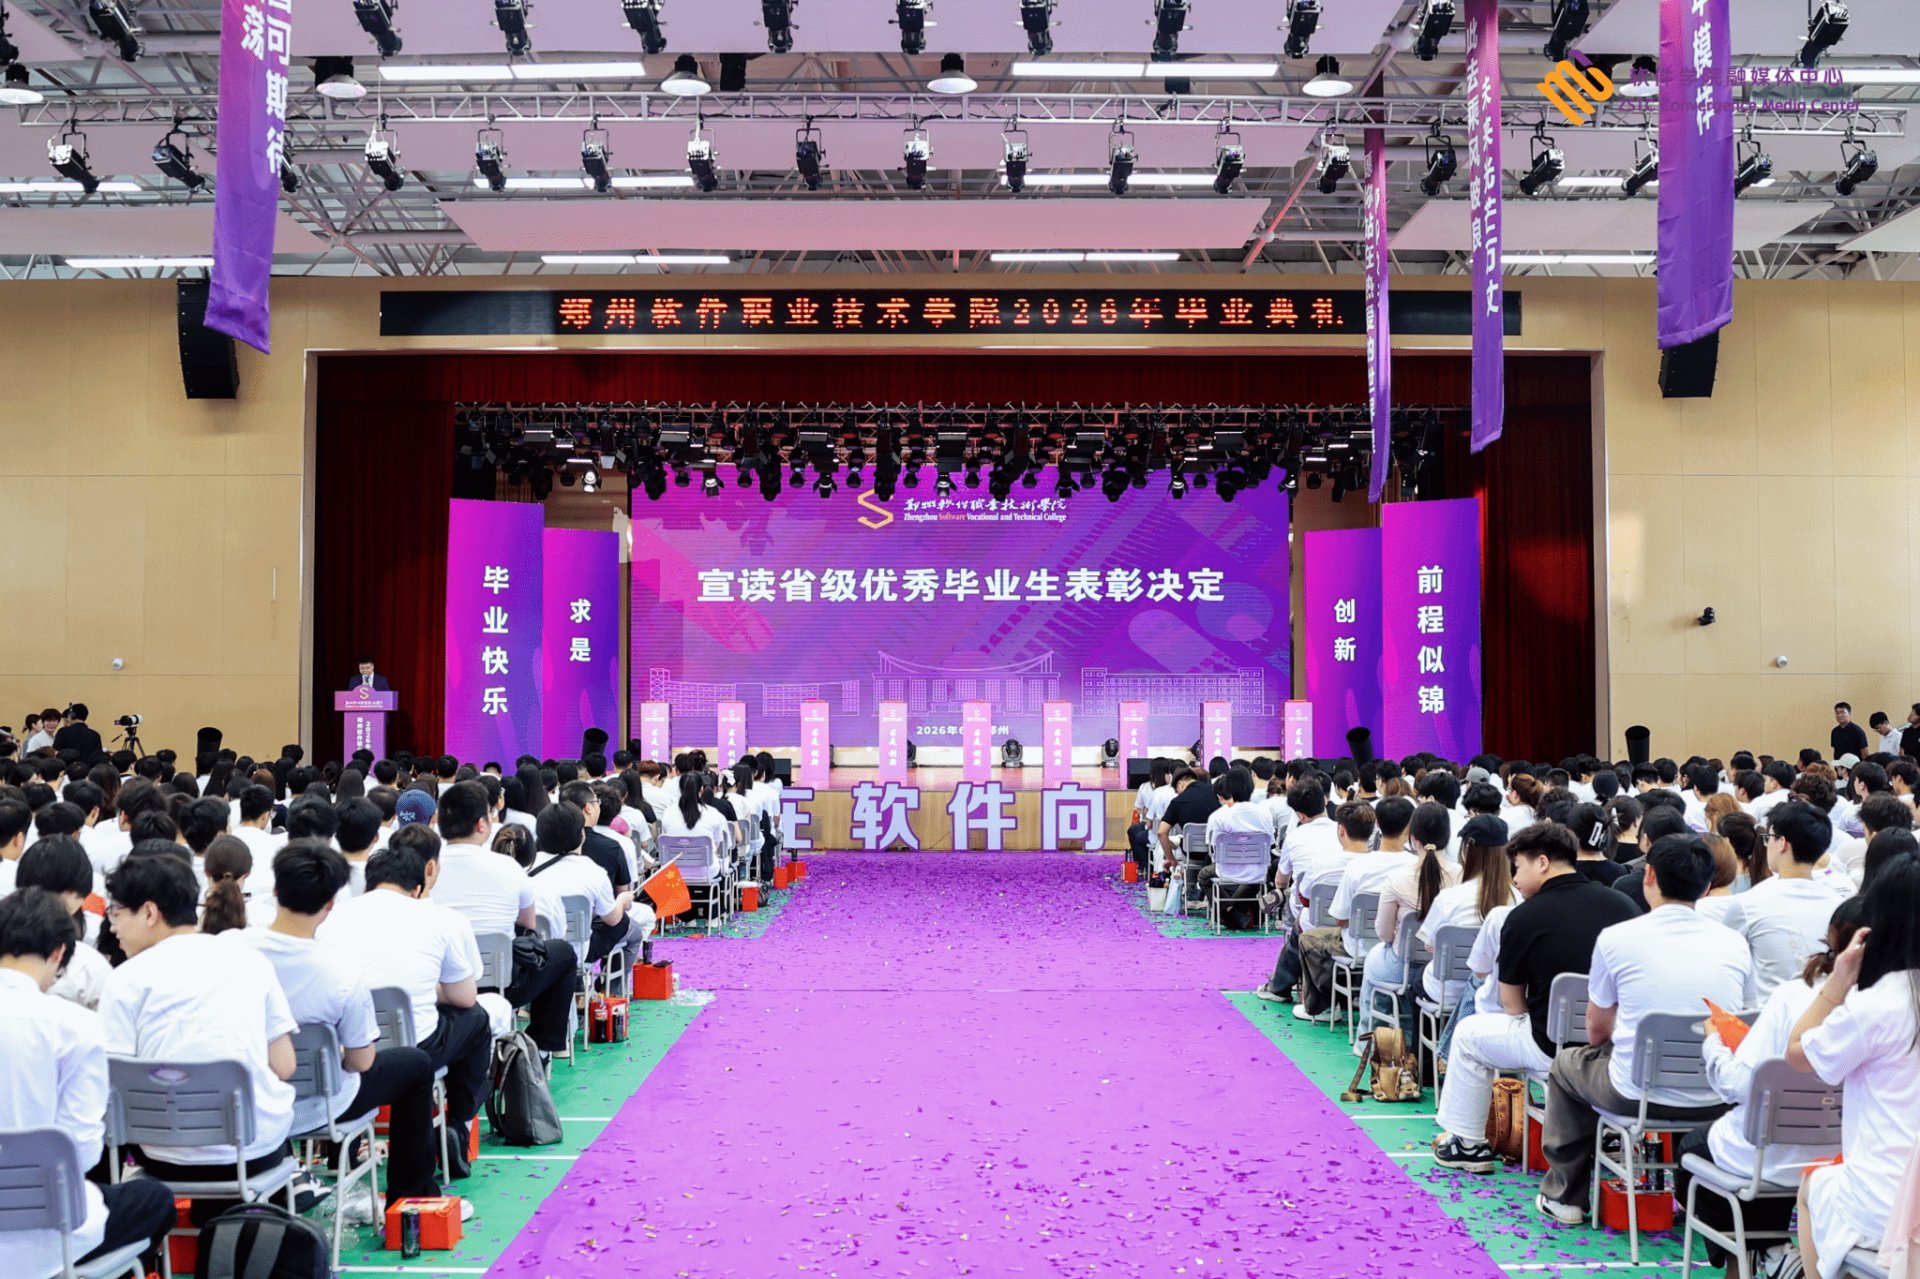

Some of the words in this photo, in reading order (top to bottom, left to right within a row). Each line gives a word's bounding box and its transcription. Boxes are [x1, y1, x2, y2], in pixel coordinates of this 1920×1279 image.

[241, 0, 265, 61] 荡
[265, 0, 292, 178] 可期待
[903, 512, 938, 523] Zhengzhou
[938, 512, 966, 522] Software
[966, 512, 999, 522] Vocational
[1000, 512, 1013, 522] and
[1013, 512, 1043, 522] Technical
[1043, 512, 1067, 523] College
[697, 567, 1226, 603] 宣读省级优秀毕业生表彰决定
[481, 565, 510, 715] 毕业快乐
[569, 598, 592, 662] 求是
[1333, 598, 1357, 662] 创新
[1417, 565, 1446, 714] 前程似锦
